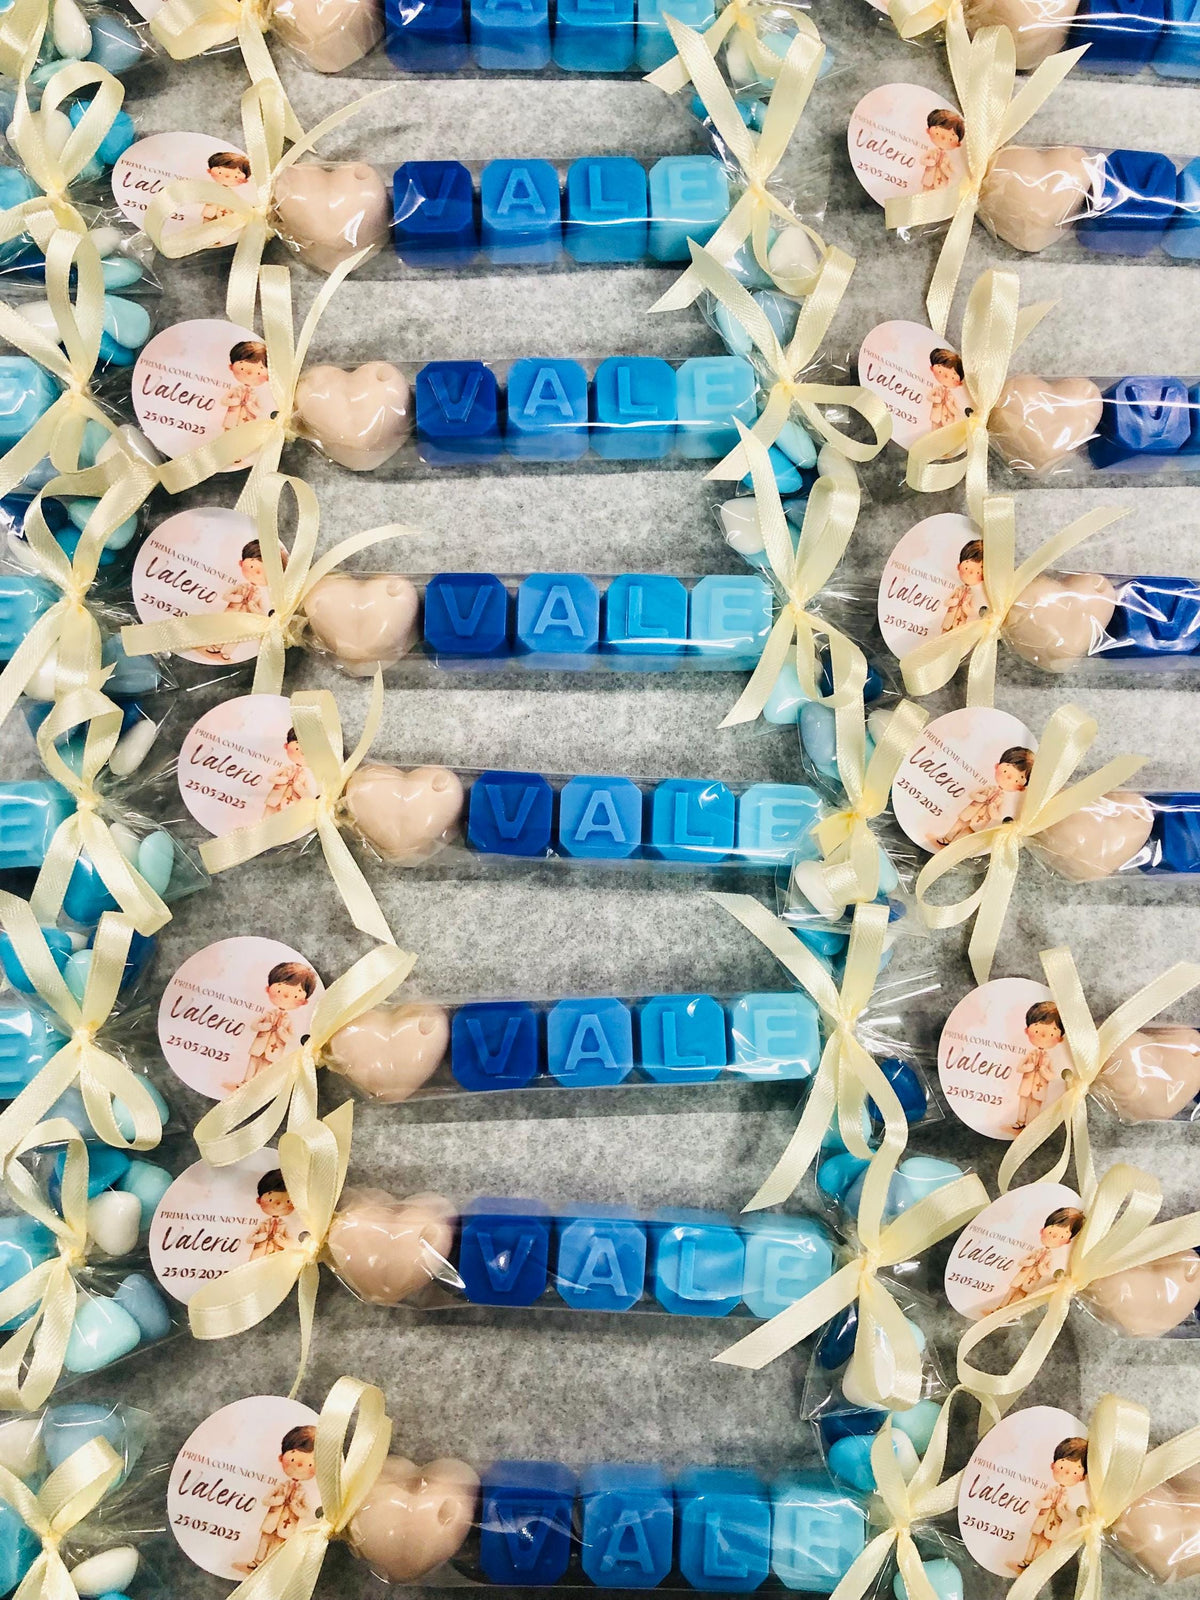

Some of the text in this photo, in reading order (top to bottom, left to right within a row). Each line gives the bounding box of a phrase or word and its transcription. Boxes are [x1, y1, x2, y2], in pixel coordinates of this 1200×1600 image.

[120, 160, 147, 172] PRIMA
[856, 128, 916, 168] Valerio
[405, 163, 708, 217] VALE
[140, 358, 166, 372] PRIMA
[168, 368, 220, 386] COMUNIONE
[866, 363, 923, 404] Valerio
[142, 374, 216, 412] Valerio
[427, 365, 736, 423] VALE
[146, 556, 218, 604] Valerio
[150, 540, 176, 558] PRIMA
[177, 554, 227, 581] COMUNIONE
[890, 560, 911, 573] PRIMA
[911, 566, 948, 588] COMUNIONE
[439, 583, 755, 637] VALE
[888, 576, 940, 612] Valerio
[190, 744, 263, 786] Valerio
[195, 728, 222, 744] PRIMA
[222, 740, 272, 764] COMUNIONE
[923, 730, 944, 750] PRIMA
[942, 744, 980, 780] COMUNIONE
[910, 746, 966, 798] Valerio
[485, 783, 801, 845] VALE
[174, 978, 200, 994] PRIMA
[202, 988, 254, 1011] COMUNIONE
[170, 995, 246, 1036] Valerio
[465, 1008, 798, 1074] VALE
[944, 1030, 968, 1042] PRIMA
[970, 1036, 1017, 1052] COMUNIONE
[946, 1046, 1012, 1080] Valerio
[160, 1210, 190, 1220] PRIMA
[191, 1213, 248, 1225] COMUNIONE
[969, 1225, 990, 1237] PRIMA
[990, 1230, 1028, 1249] COMUNIONE
[162, 1226, 242, 1253] Valerio
[958, 1239, 1014, 1272] Valerio
[476, 1231, 816, 1300] VALE
[182, 1450, 210, 1466] PRIMA
[212, 1460, 268, 1482] COMUNIONE
[974, 1457, 996, 1471] PRIMA
[997, 1464, 1039, 1486] COMUNIONE
[178, 1469, 257, 1512] Valerio
[968, 1474, 1031, 1515] Valerio
[504, 1505, 842, 1578] VALE
